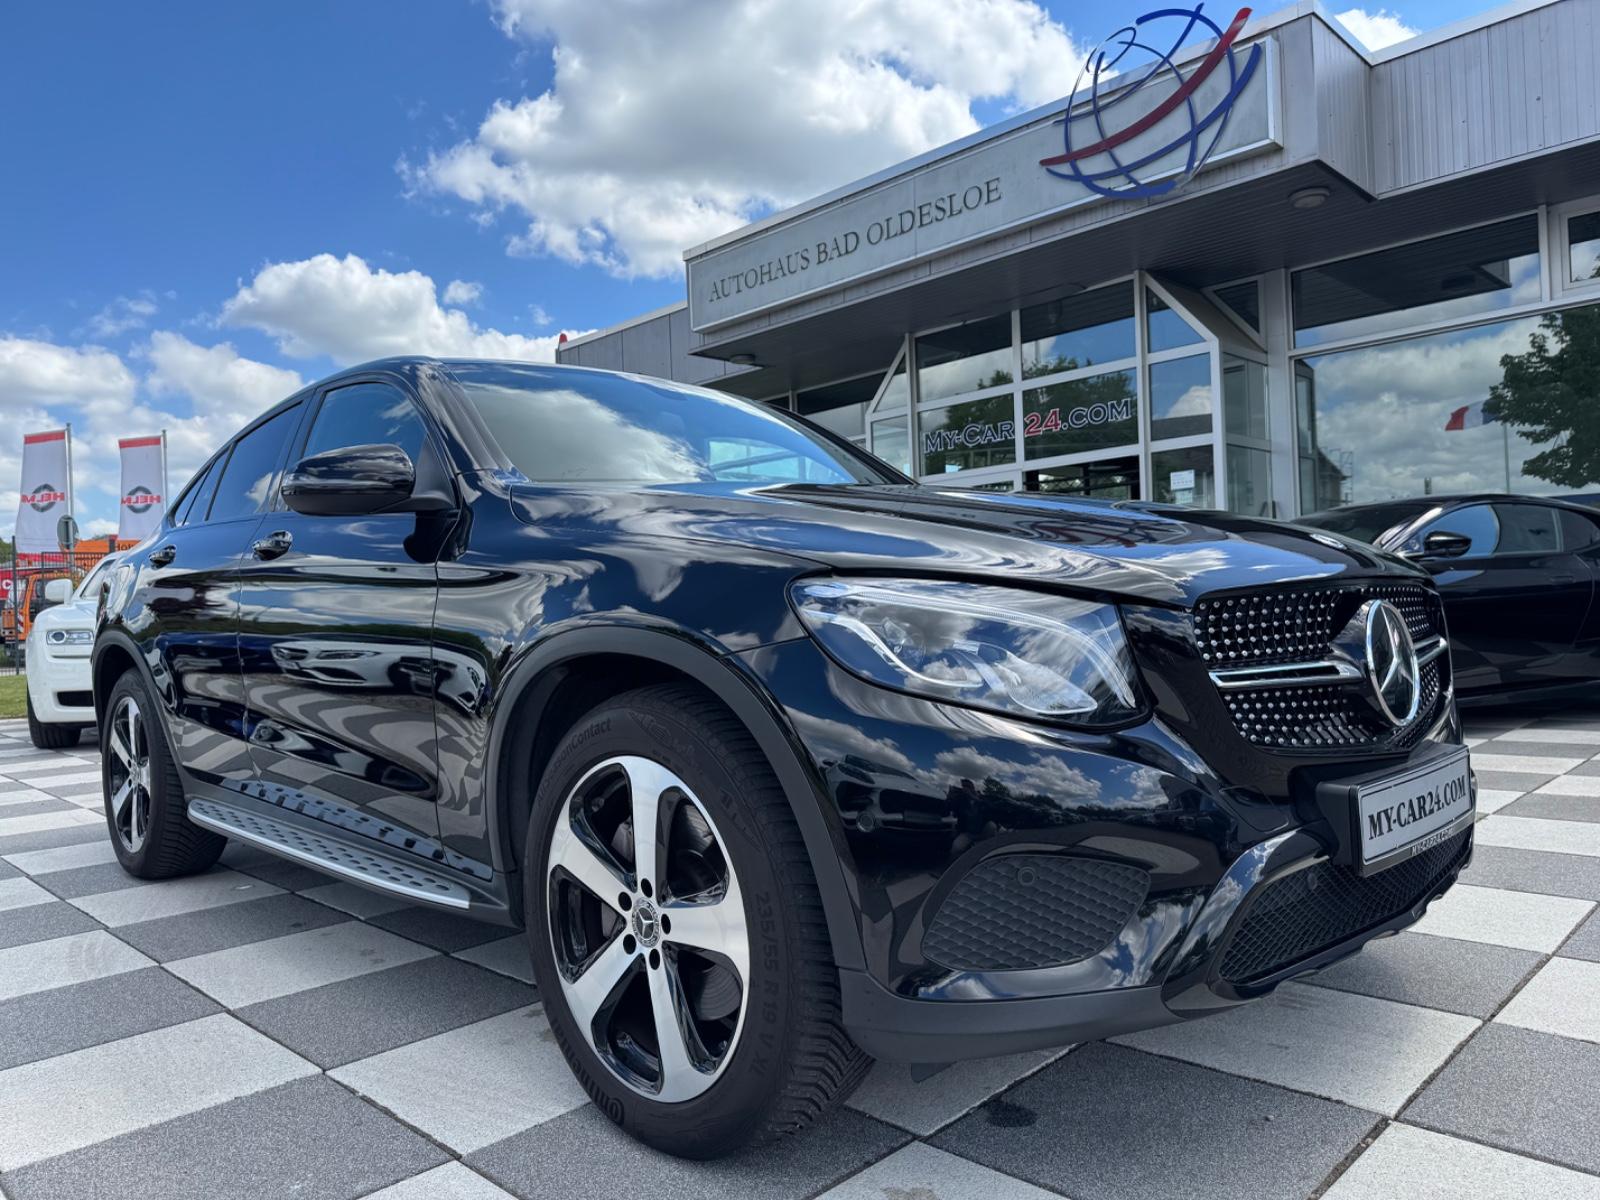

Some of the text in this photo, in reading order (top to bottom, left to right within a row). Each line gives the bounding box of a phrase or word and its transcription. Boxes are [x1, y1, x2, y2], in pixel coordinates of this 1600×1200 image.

[709, 177, 1002, 303] AUTOHAUS BAD OLDESLOE
[1368, 775, 1467, 841] MY-CAR24.COM
[755, 890, 779, 973] 235/55
